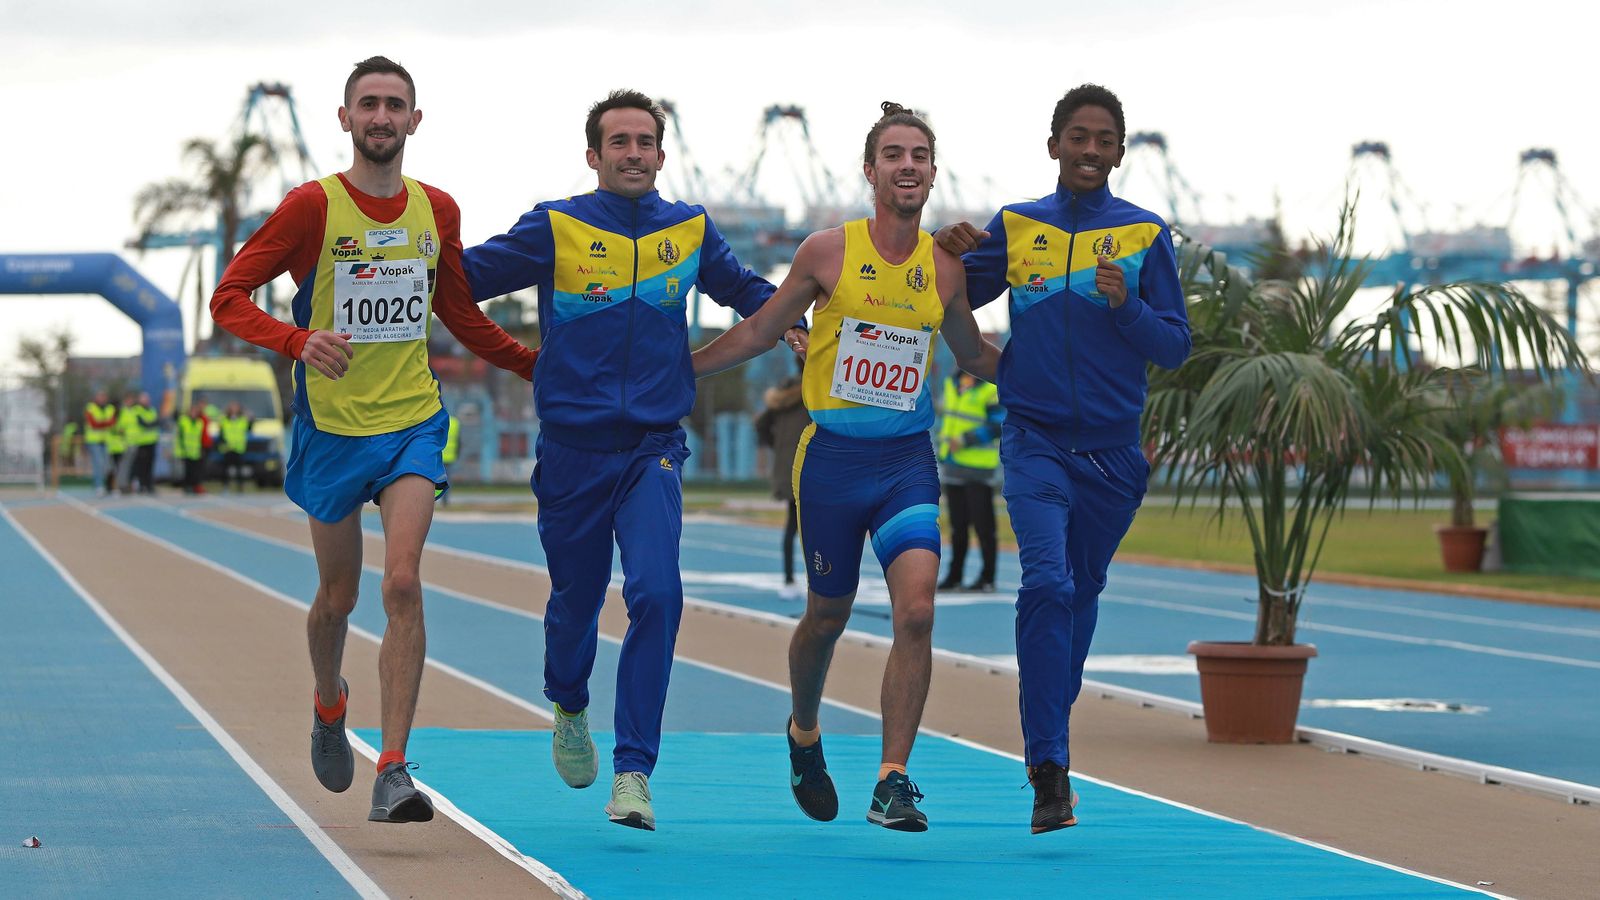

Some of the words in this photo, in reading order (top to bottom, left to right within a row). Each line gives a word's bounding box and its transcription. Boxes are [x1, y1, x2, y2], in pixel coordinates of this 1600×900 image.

[331, 248, 363, 258] Vopak
[379, 265, 415, 277] Vopak
[1025, 285, 1049, 293] Vopak
[581, 294, 613, 303] Vopak
[342, 295, 423, 325] 1002C
[884, 330, 919, 346] Vopak
[842, 355, 920, 394] 1002D
[846, 392, 867, 401] CIUDAD
[876, 398, 904, 407] ALGECIRAS
[857, 387, 874, 395] MEDIA
[875, 391, 902, 400] MARATHON
